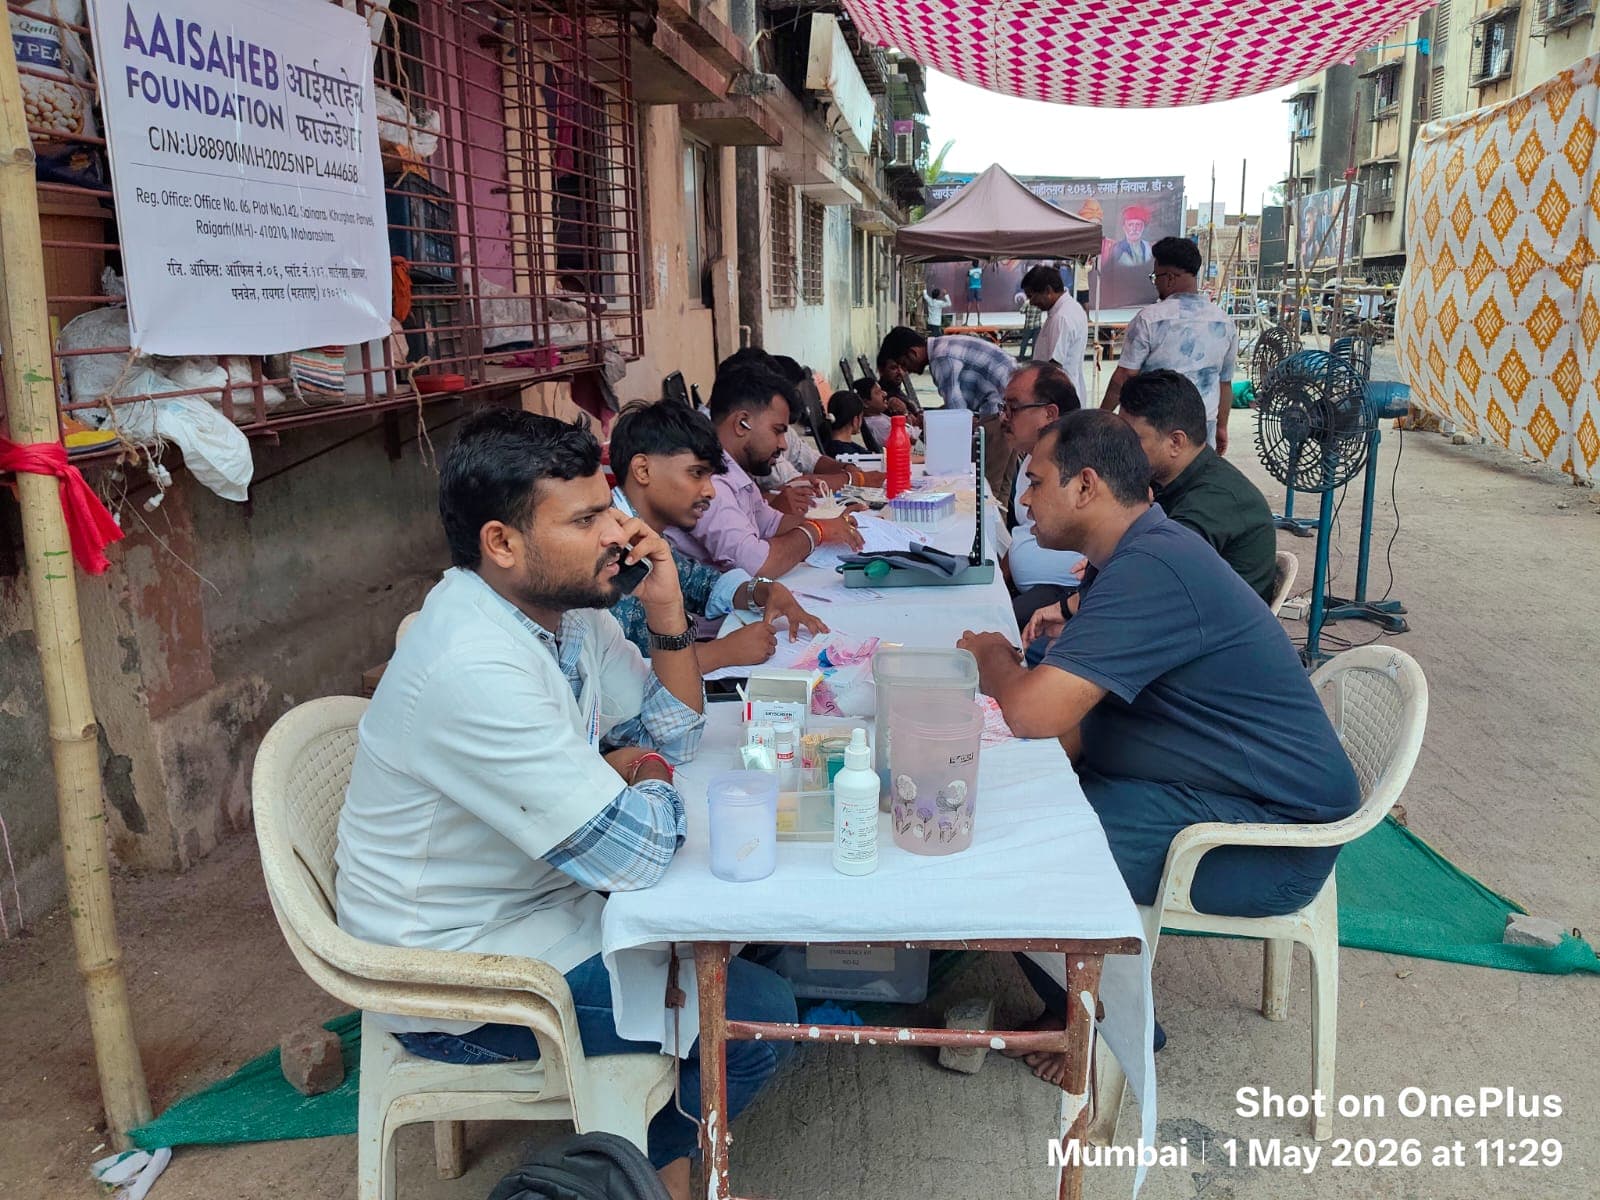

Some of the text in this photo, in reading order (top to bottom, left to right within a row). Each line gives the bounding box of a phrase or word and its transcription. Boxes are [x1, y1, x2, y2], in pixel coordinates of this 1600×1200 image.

[123, 3, 280, 91] AAISAHEB
[126, 66, 285, 131] FOUNDATION
[286, 57, 365, 116] आईसाहेब
[1120, 179, 1150, 193] निवास,
[136, 187, 160, 208] Reg.
[161, 190, 193, 208] Office:
[194, 194, 221, 211] Office
[223, 197, 239, 212] No.
[252, 200, 269, 216] Plot
[259, 223, 289, 242] 410210,
[167, 258, 187, 277] रजि.
[189, 259, 223, 277] ऑफिस:
[225, 260, 255, 278] ऑफिस
[231, 283, 260, 304] पनवेल,
